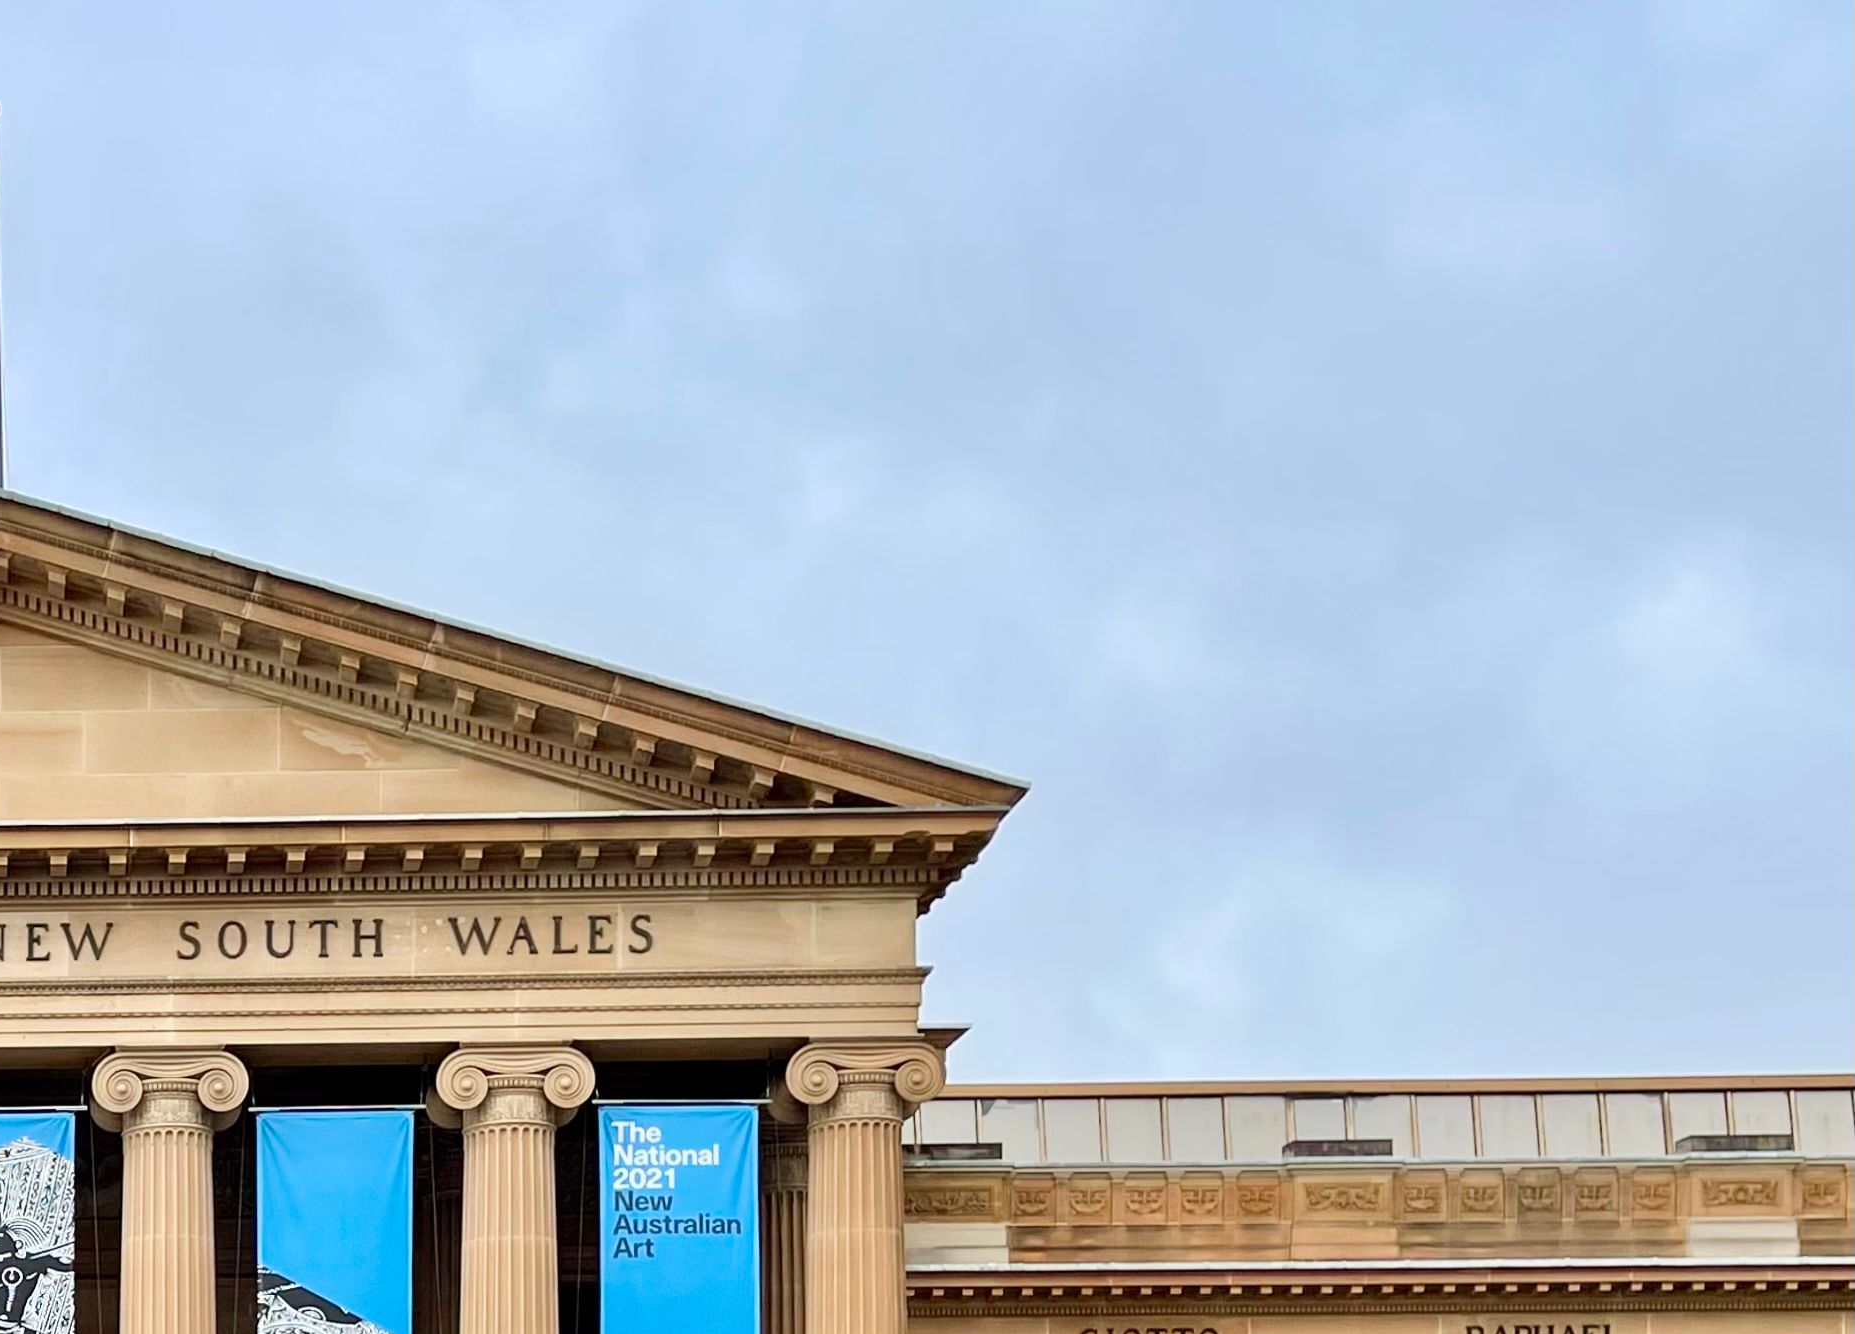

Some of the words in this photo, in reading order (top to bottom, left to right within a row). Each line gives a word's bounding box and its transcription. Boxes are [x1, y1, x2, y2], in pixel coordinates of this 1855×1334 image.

[176, 918, 384, 961] SOUTH
[447, 914, 654, 956] WALES
[611, 1121, 662, 1143] The
[613, 1144, 720, 1166] National
[613, 1167, 676, 1190] 2021
[614, 1190, 673, 1212] New
[613, 1212, 742, 1235] Australian
[613, 1236, 655, 1259] Art
